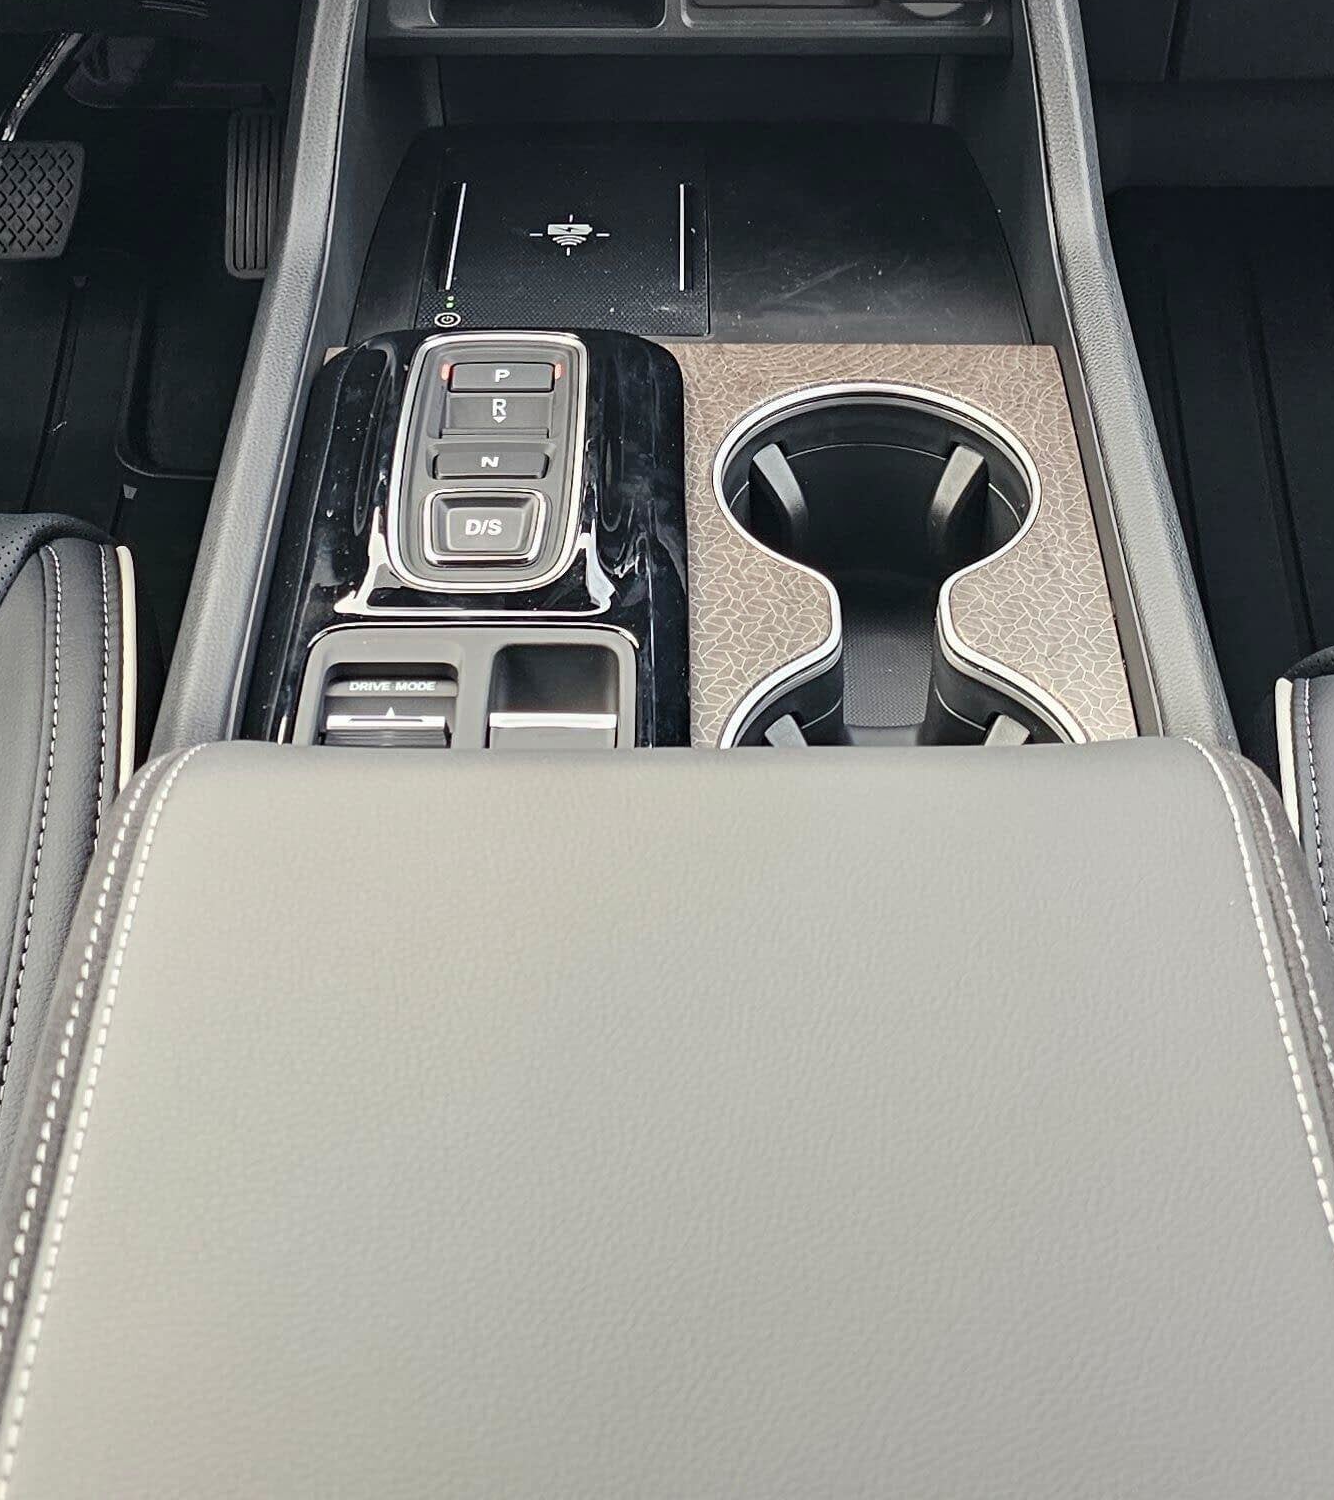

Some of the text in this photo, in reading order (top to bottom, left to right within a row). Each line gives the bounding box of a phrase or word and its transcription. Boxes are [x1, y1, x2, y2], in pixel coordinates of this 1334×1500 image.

[495, 369, 510, 382] P
[492, 398, 507, 416] R
[481, 456, 499, 467] N
[465, 519, 503, 536] D/S
[349, 681, 436, 691] DRIVE MODE
